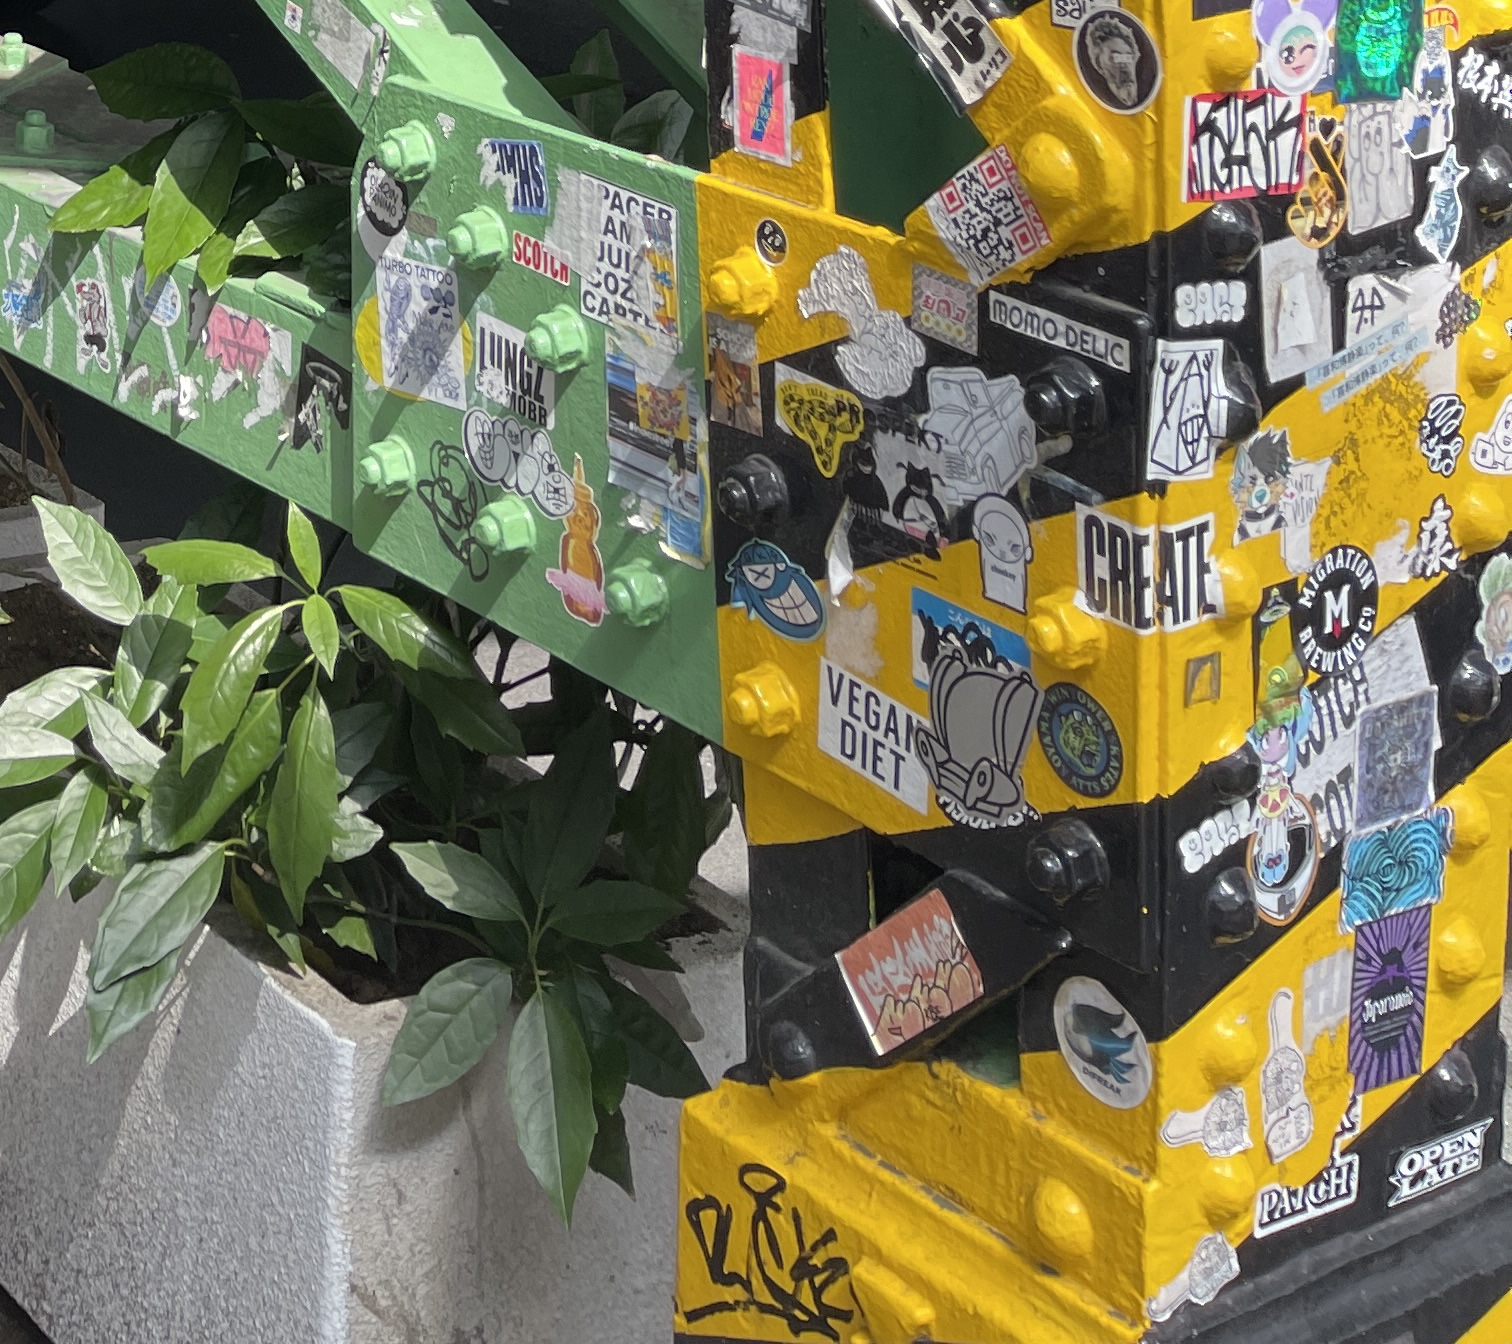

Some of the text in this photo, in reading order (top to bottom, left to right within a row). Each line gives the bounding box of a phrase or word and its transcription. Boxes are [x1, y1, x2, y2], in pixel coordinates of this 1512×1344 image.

[600, 183, 673, 221] PACER
[1025, 201, 1052, 247] SCAN
[379, 255, 453, 286] TURBO TATTOO
[514, 233, 569, 284] SCOTCH
[992, 296, 1126, 369] MOMO DELIC
[1298, 548, 1376, 609] MIGRATION
[1299, 626, 1366, 674] BREWING
[826, 665, 924, 755] VEGAN
[839, 718, 906, 793] DIET
[1083, 1067, 1123, 1096] DIFREAK
[1398, 1133, 1483, 1179] OPEN
[1401, 1152, 1483, 1204] LATE
